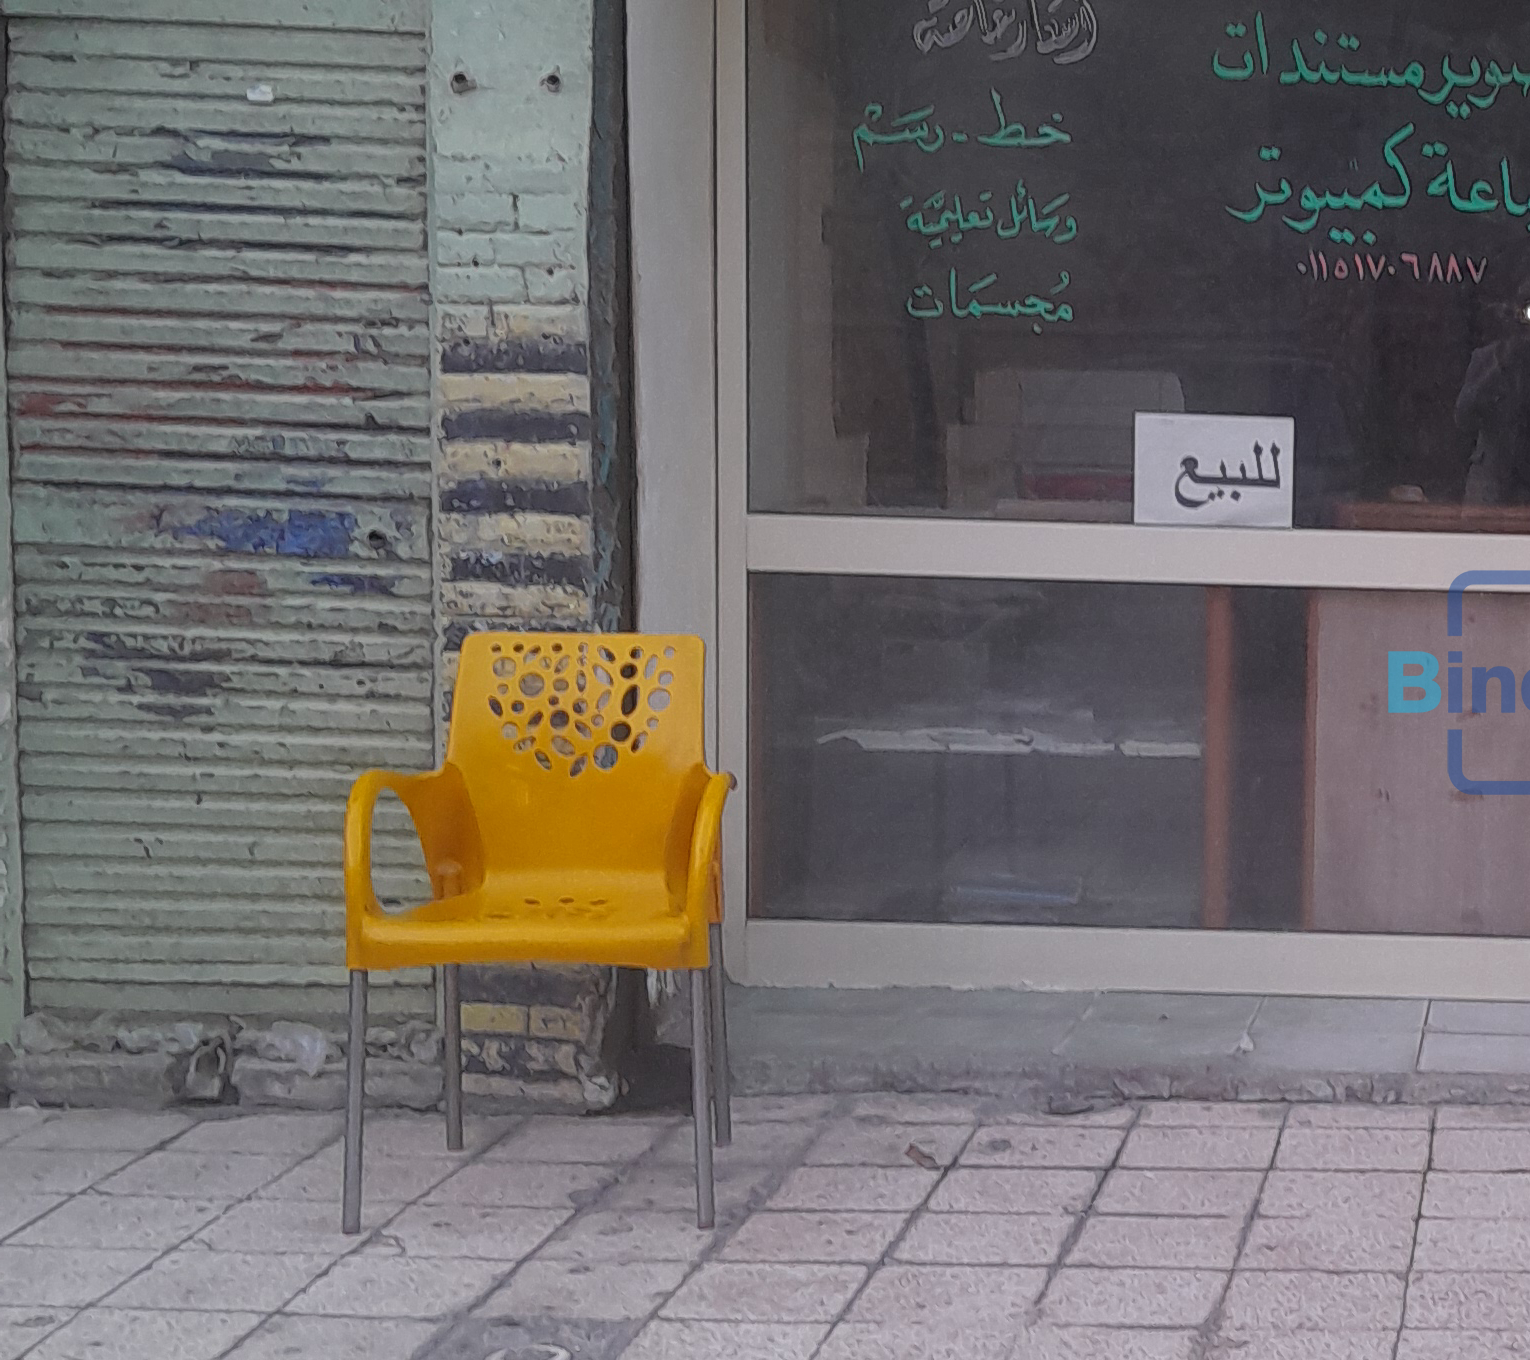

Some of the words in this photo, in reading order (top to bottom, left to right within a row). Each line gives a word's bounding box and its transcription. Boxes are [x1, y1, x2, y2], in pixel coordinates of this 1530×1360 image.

[1212, 10, 1425, 87] مستندات
[977, 87, 1073, 147] خط
[1225, 122, 1415, 245] كمبيوتر
[1297, 248, 1488, 285] ٠١١٥١٧٠٦٨٨٧
[1173, 439, 1281, 508] للبيع
